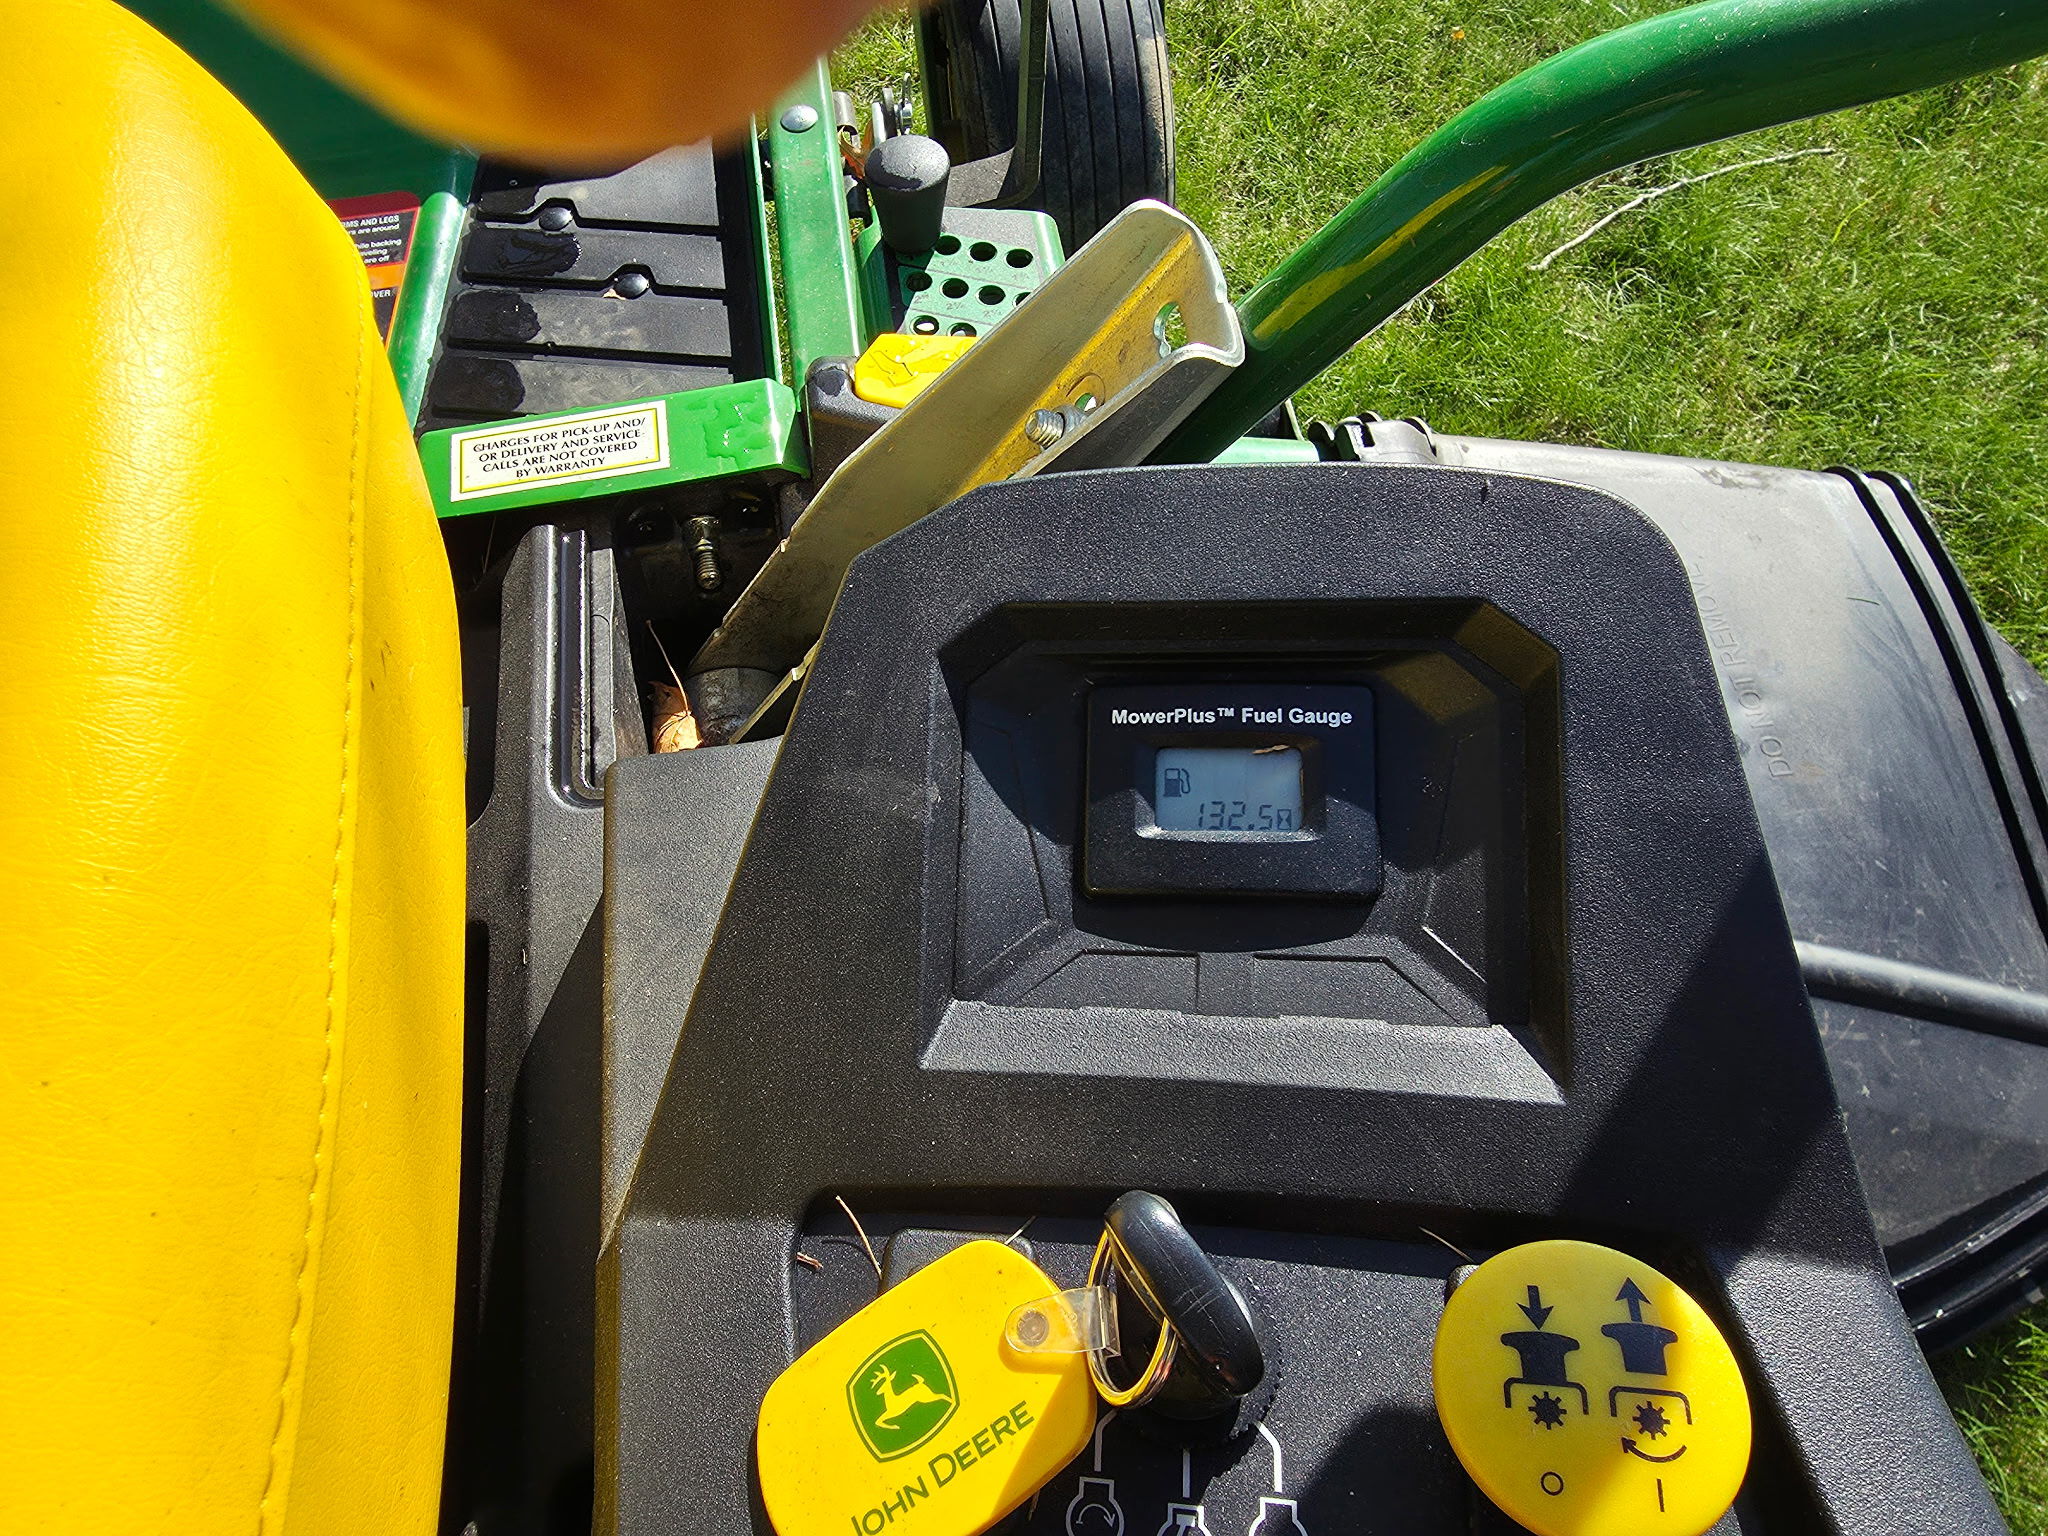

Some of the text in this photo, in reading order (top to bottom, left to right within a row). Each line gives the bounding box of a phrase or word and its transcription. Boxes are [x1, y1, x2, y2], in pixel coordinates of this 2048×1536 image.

[360, 217, 378, 226] AND
[379, 214, 400, 224] LEGS
[372, 223, 400, 233] around
[370, 239, 402, 248] backing
[473, 417, 647, 453] CHARGES FOR PICK-UP AND/
[478, 428, 641, 462] OR DELIVERY AND SERVICE
[482, 441, 638, 472] CALLS ARE NOT COVERED
[516, 457, 606, 478] BY WARRANTY
[1729, 675, 1775, 729] NOT
[1241, 708, 1283, 723] Fuel
[1288, 708, 1352, 727] Gauge
[1759, 735, 1793, 778] DO
[1198, 801, 1274, 831] 132.5
[851, 1400, 1035, 1536] JOHN DEERE
